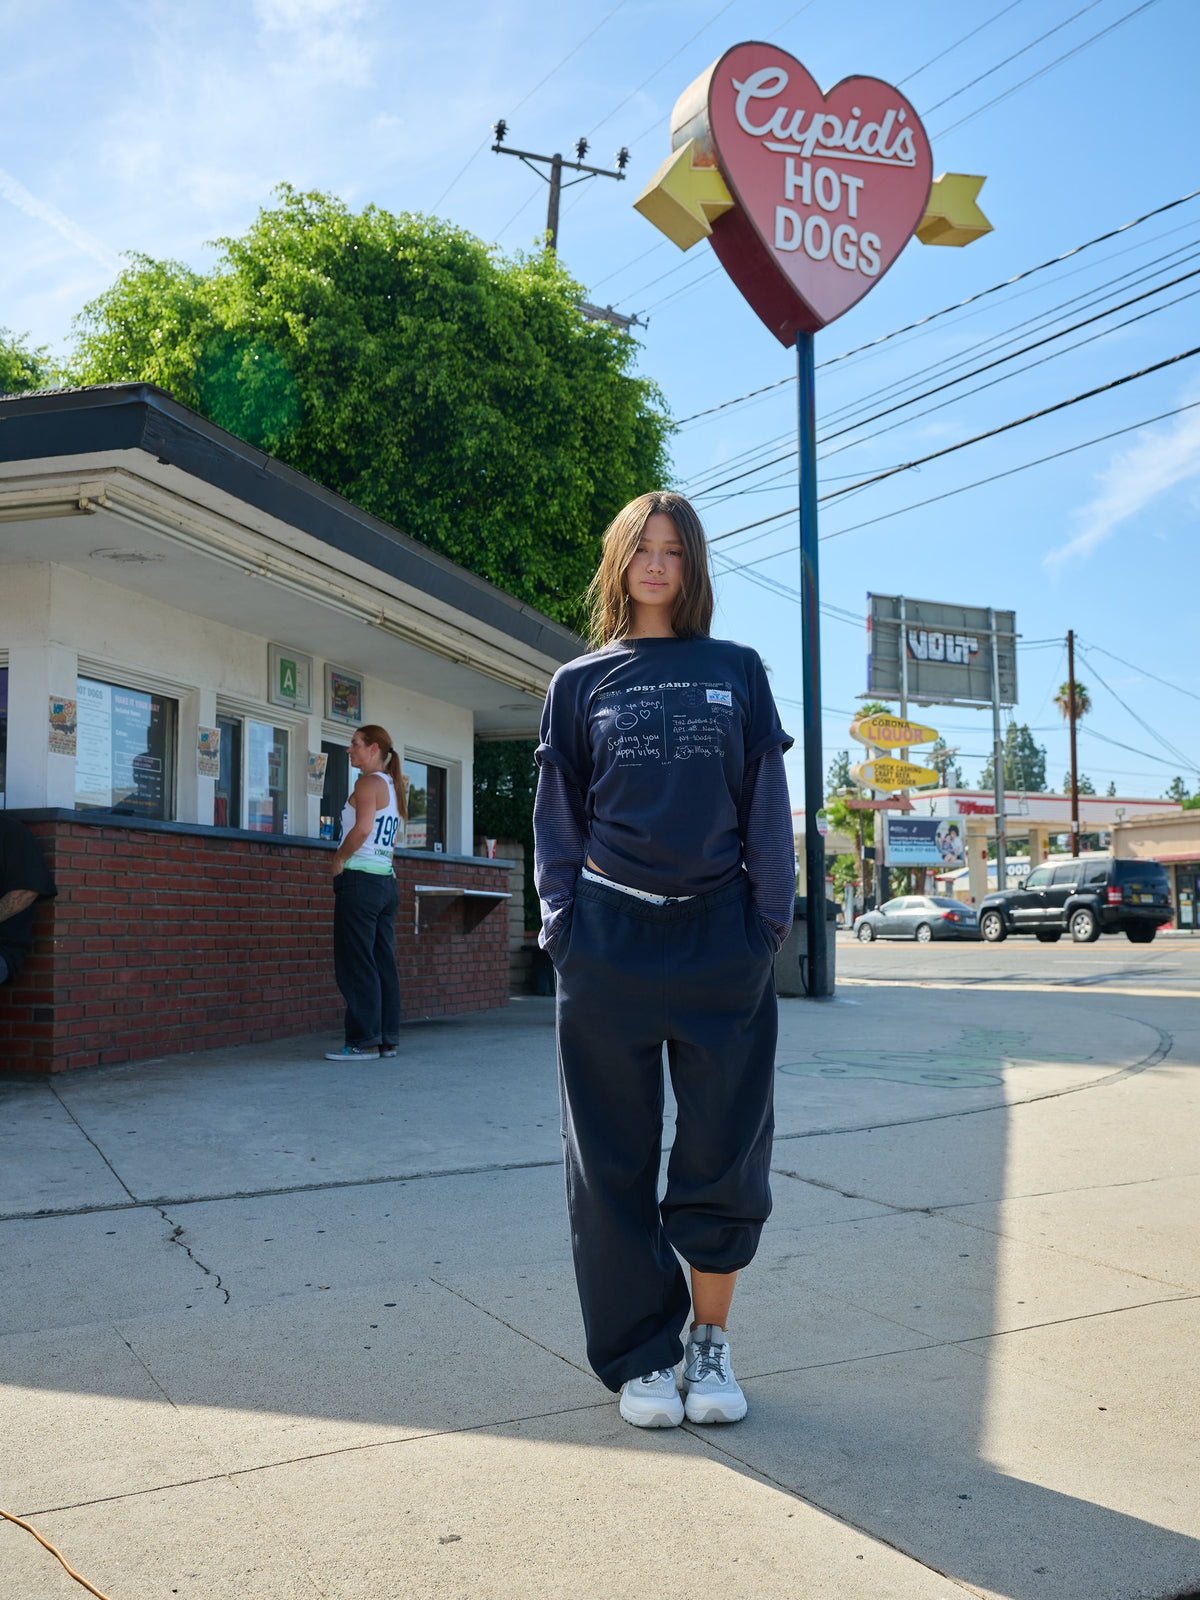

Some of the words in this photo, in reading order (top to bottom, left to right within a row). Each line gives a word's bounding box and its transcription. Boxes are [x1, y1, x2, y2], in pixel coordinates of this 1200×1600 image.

[731, 67, 917, 163] Cupid's
[784, 157, 864, 219] HOT
[774, 205, 882, 278] DOGS
[907, 629, 979, 665] VOLT
[283, 668, 294, 690] A
[626, 685, 656, 693] POST
[872, 719, 911, 729] CORONA
[642, 734, 660, 747] you
[868, 726, 924, 743] LIQUOR
[637, 746, 661, 759] vibes
[875, 777, 895, 785] MONEY
